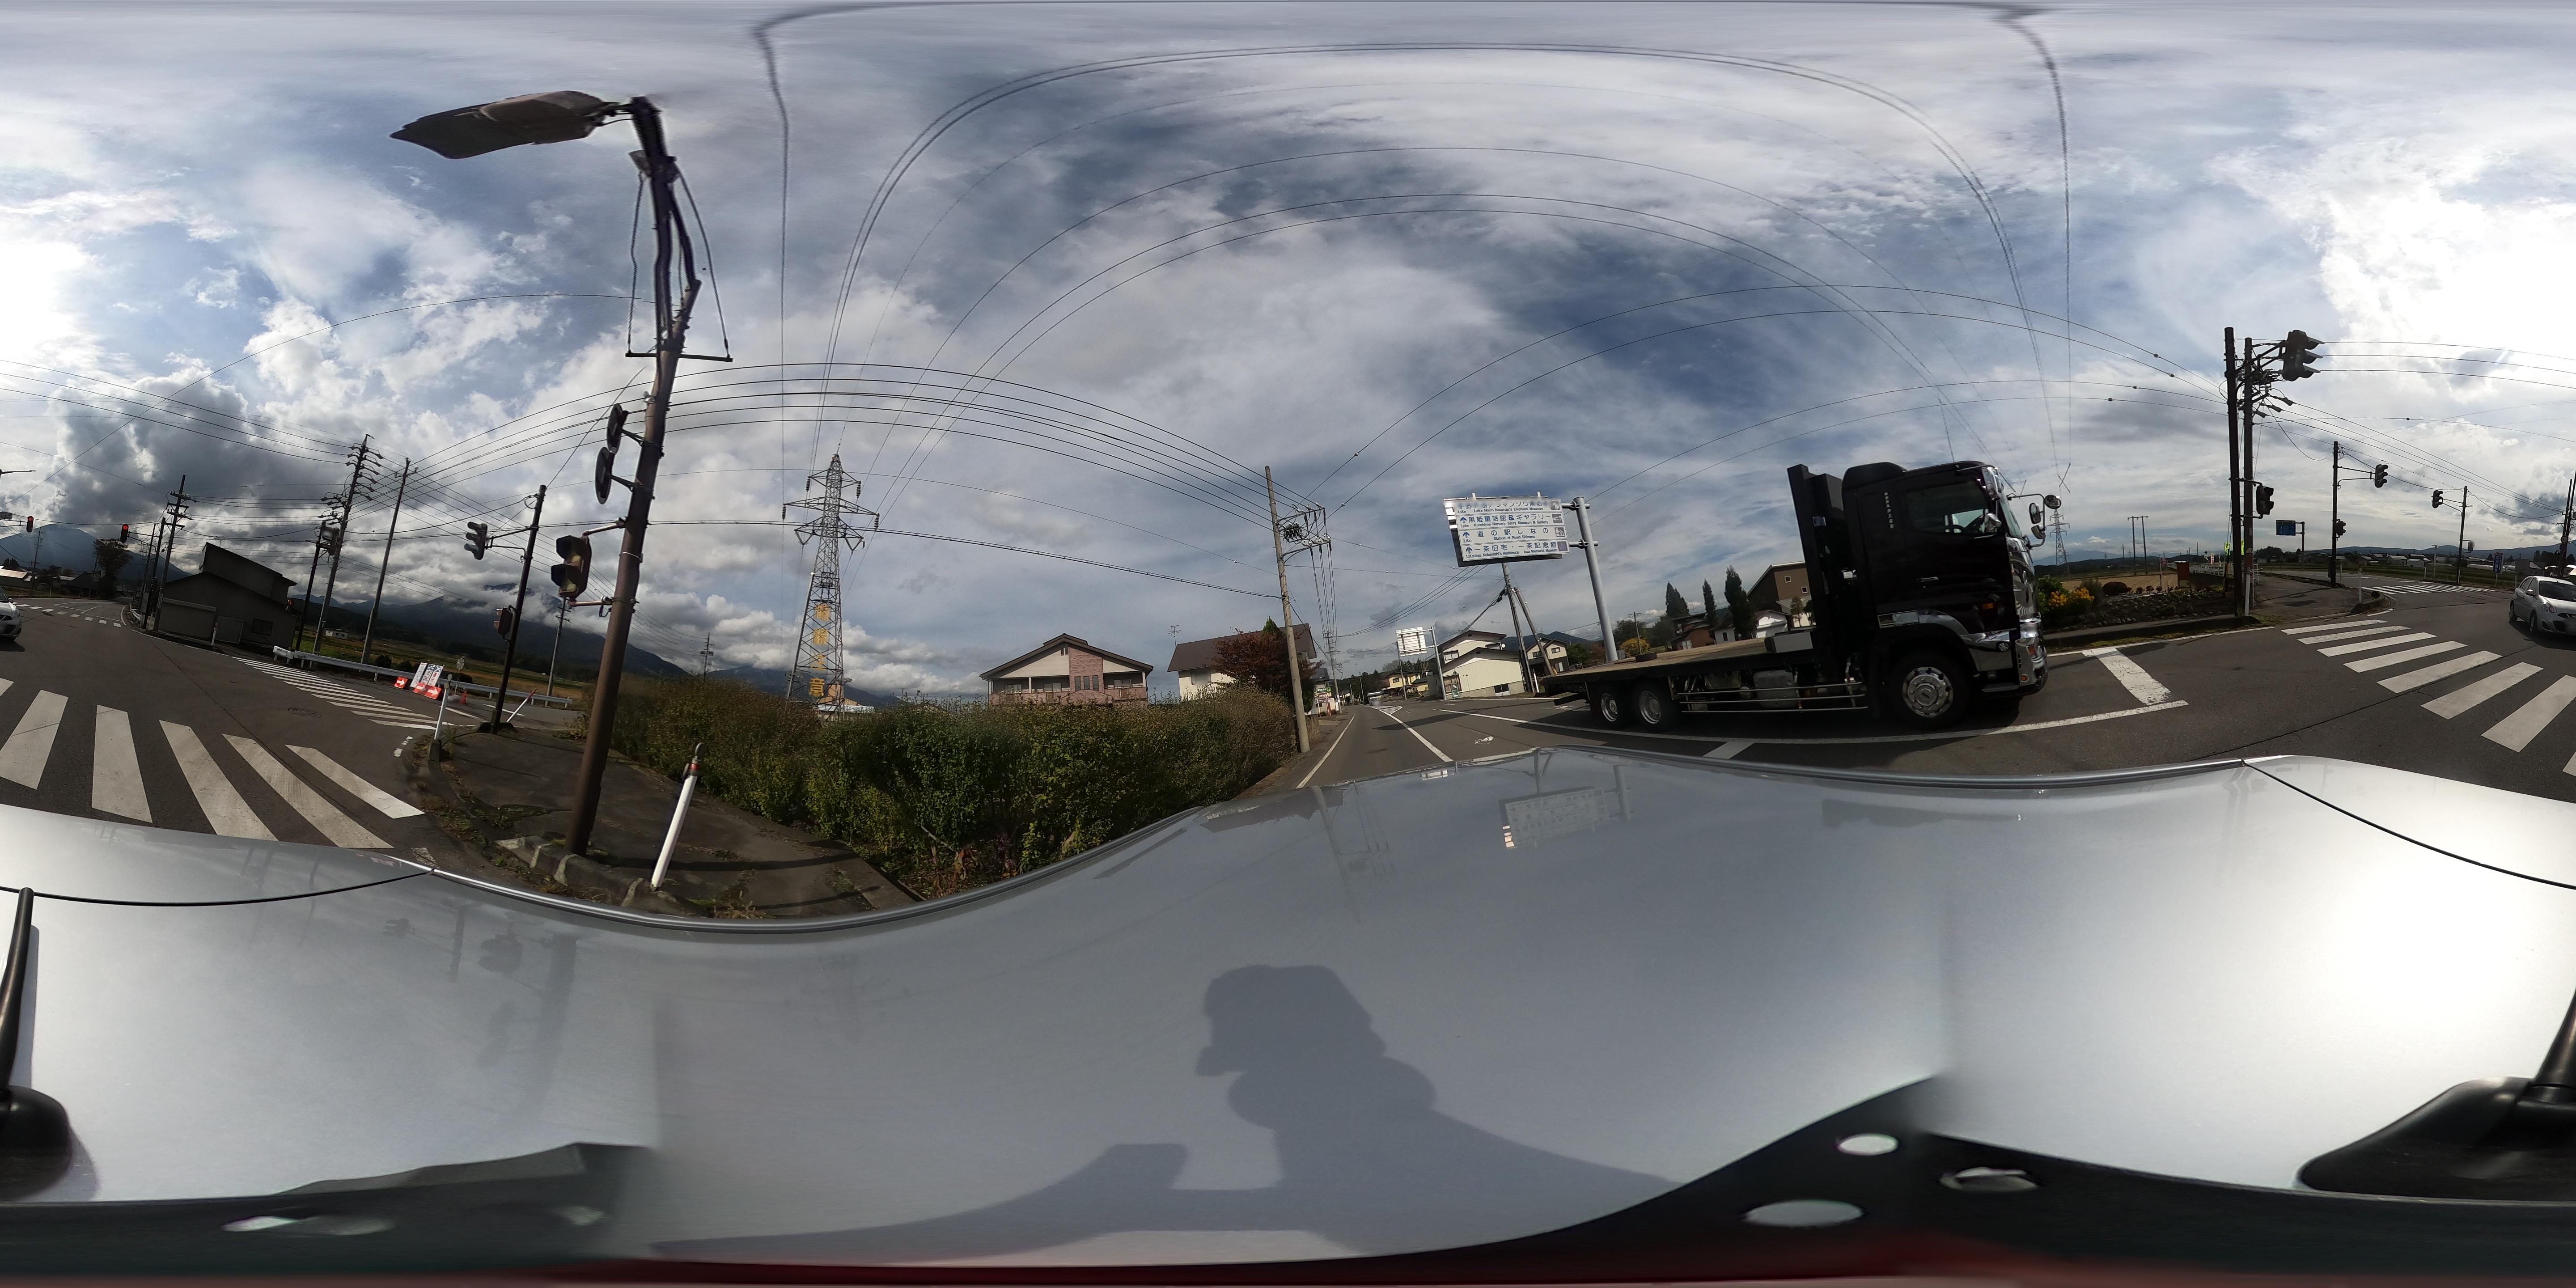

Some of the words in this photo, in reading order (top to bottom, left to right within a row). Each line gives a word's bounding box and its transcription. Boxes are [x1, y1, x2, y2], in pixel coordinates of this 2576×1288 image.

[1477, 528, 1548, 537] 道の駅しなの
